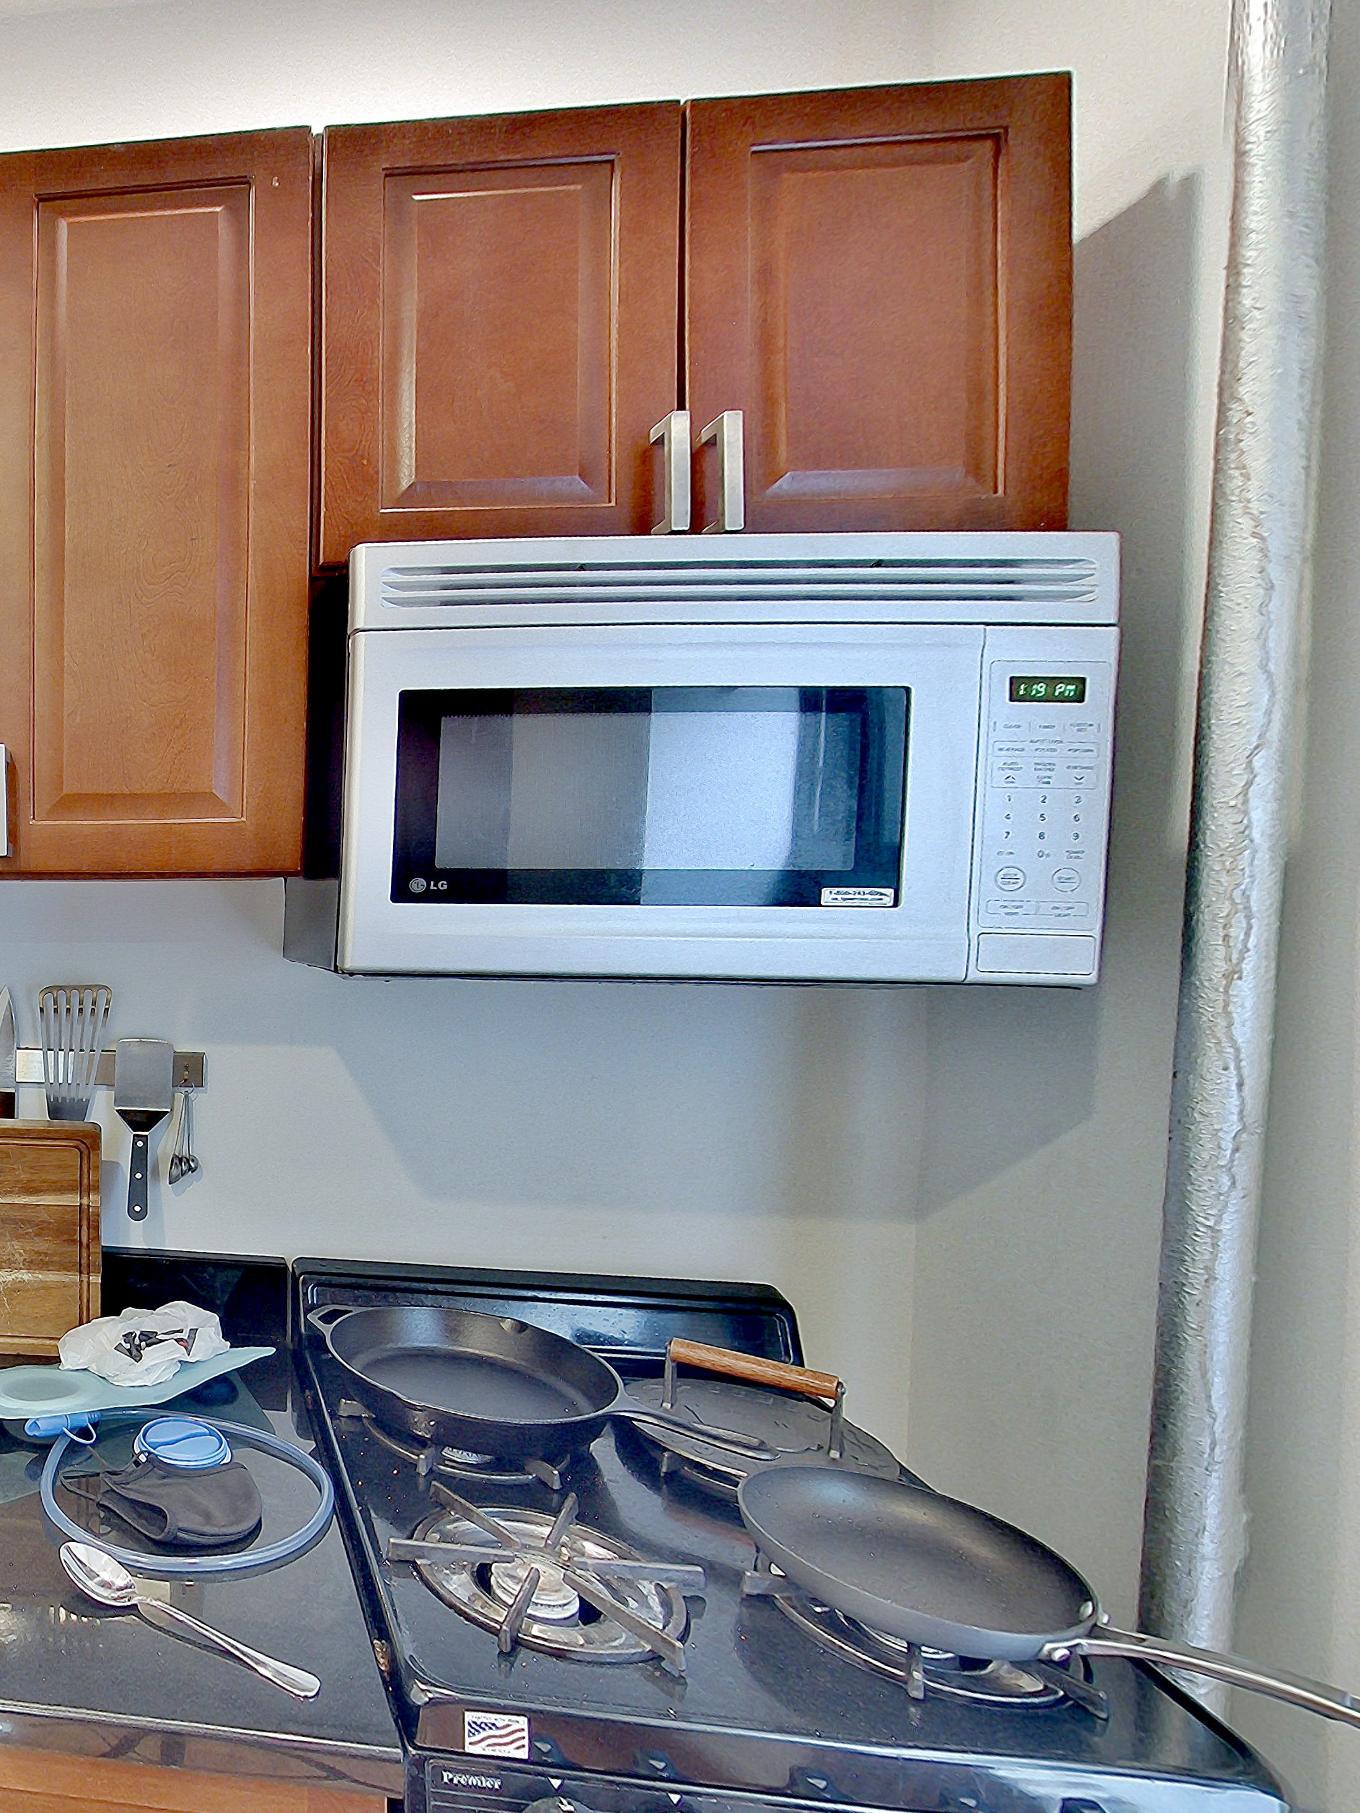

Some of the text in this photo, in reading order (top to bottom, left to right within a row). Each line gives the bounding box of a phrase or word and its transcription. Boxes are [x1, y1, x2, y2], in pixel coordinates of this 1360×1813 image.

[1018, 683, 1076, 698] 1:19 PM
[1040, 794, 1048, 804] 2
[429, 880, 448, 890] LG
[441, 1769, 504, 1791] Premier
